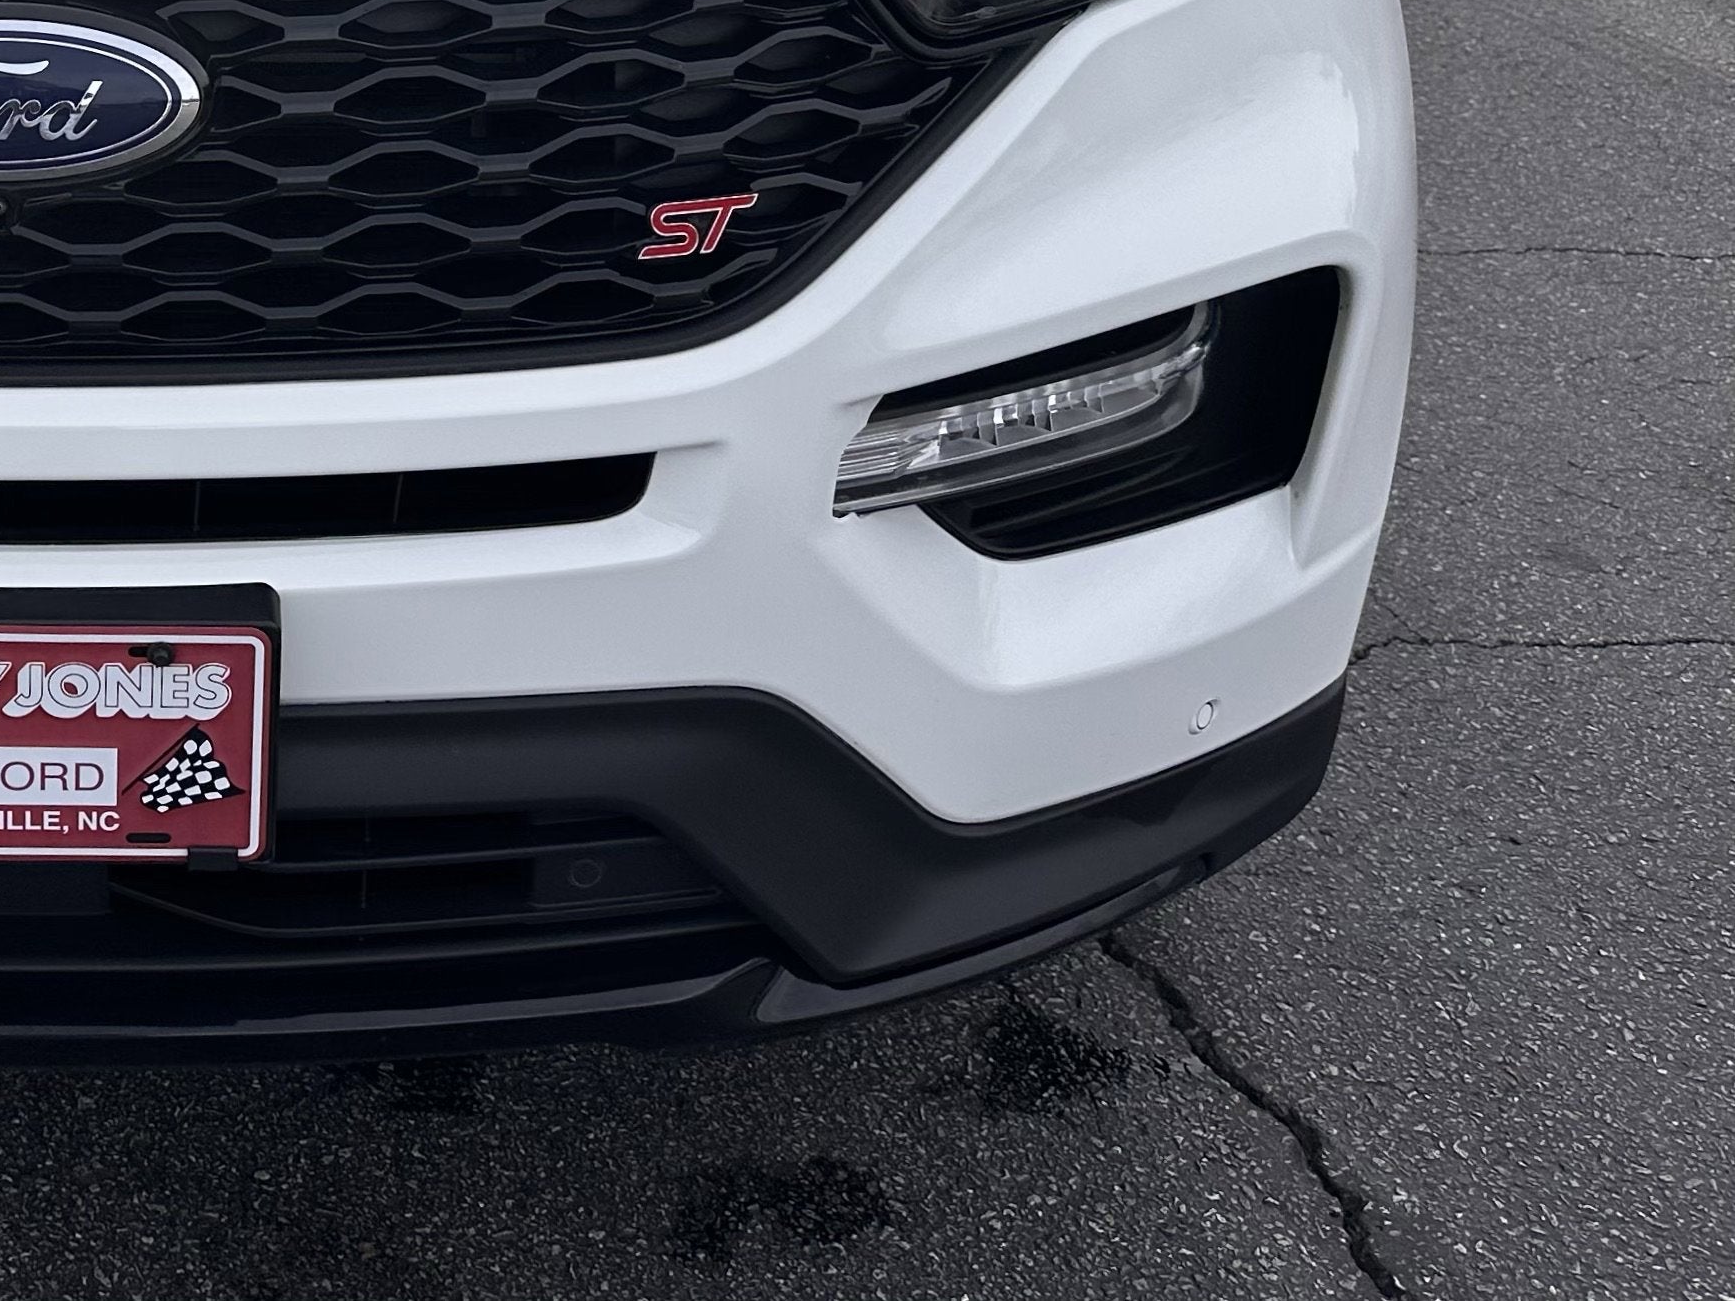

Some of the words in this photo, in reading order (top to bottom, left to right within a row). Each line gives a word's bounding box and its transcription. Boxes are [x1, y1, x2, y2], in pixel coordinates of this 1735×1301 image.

[637, 193, 759, 260] ST
[2, 660, 233, 721] JONES
[78, 811, 121, 832] NC
